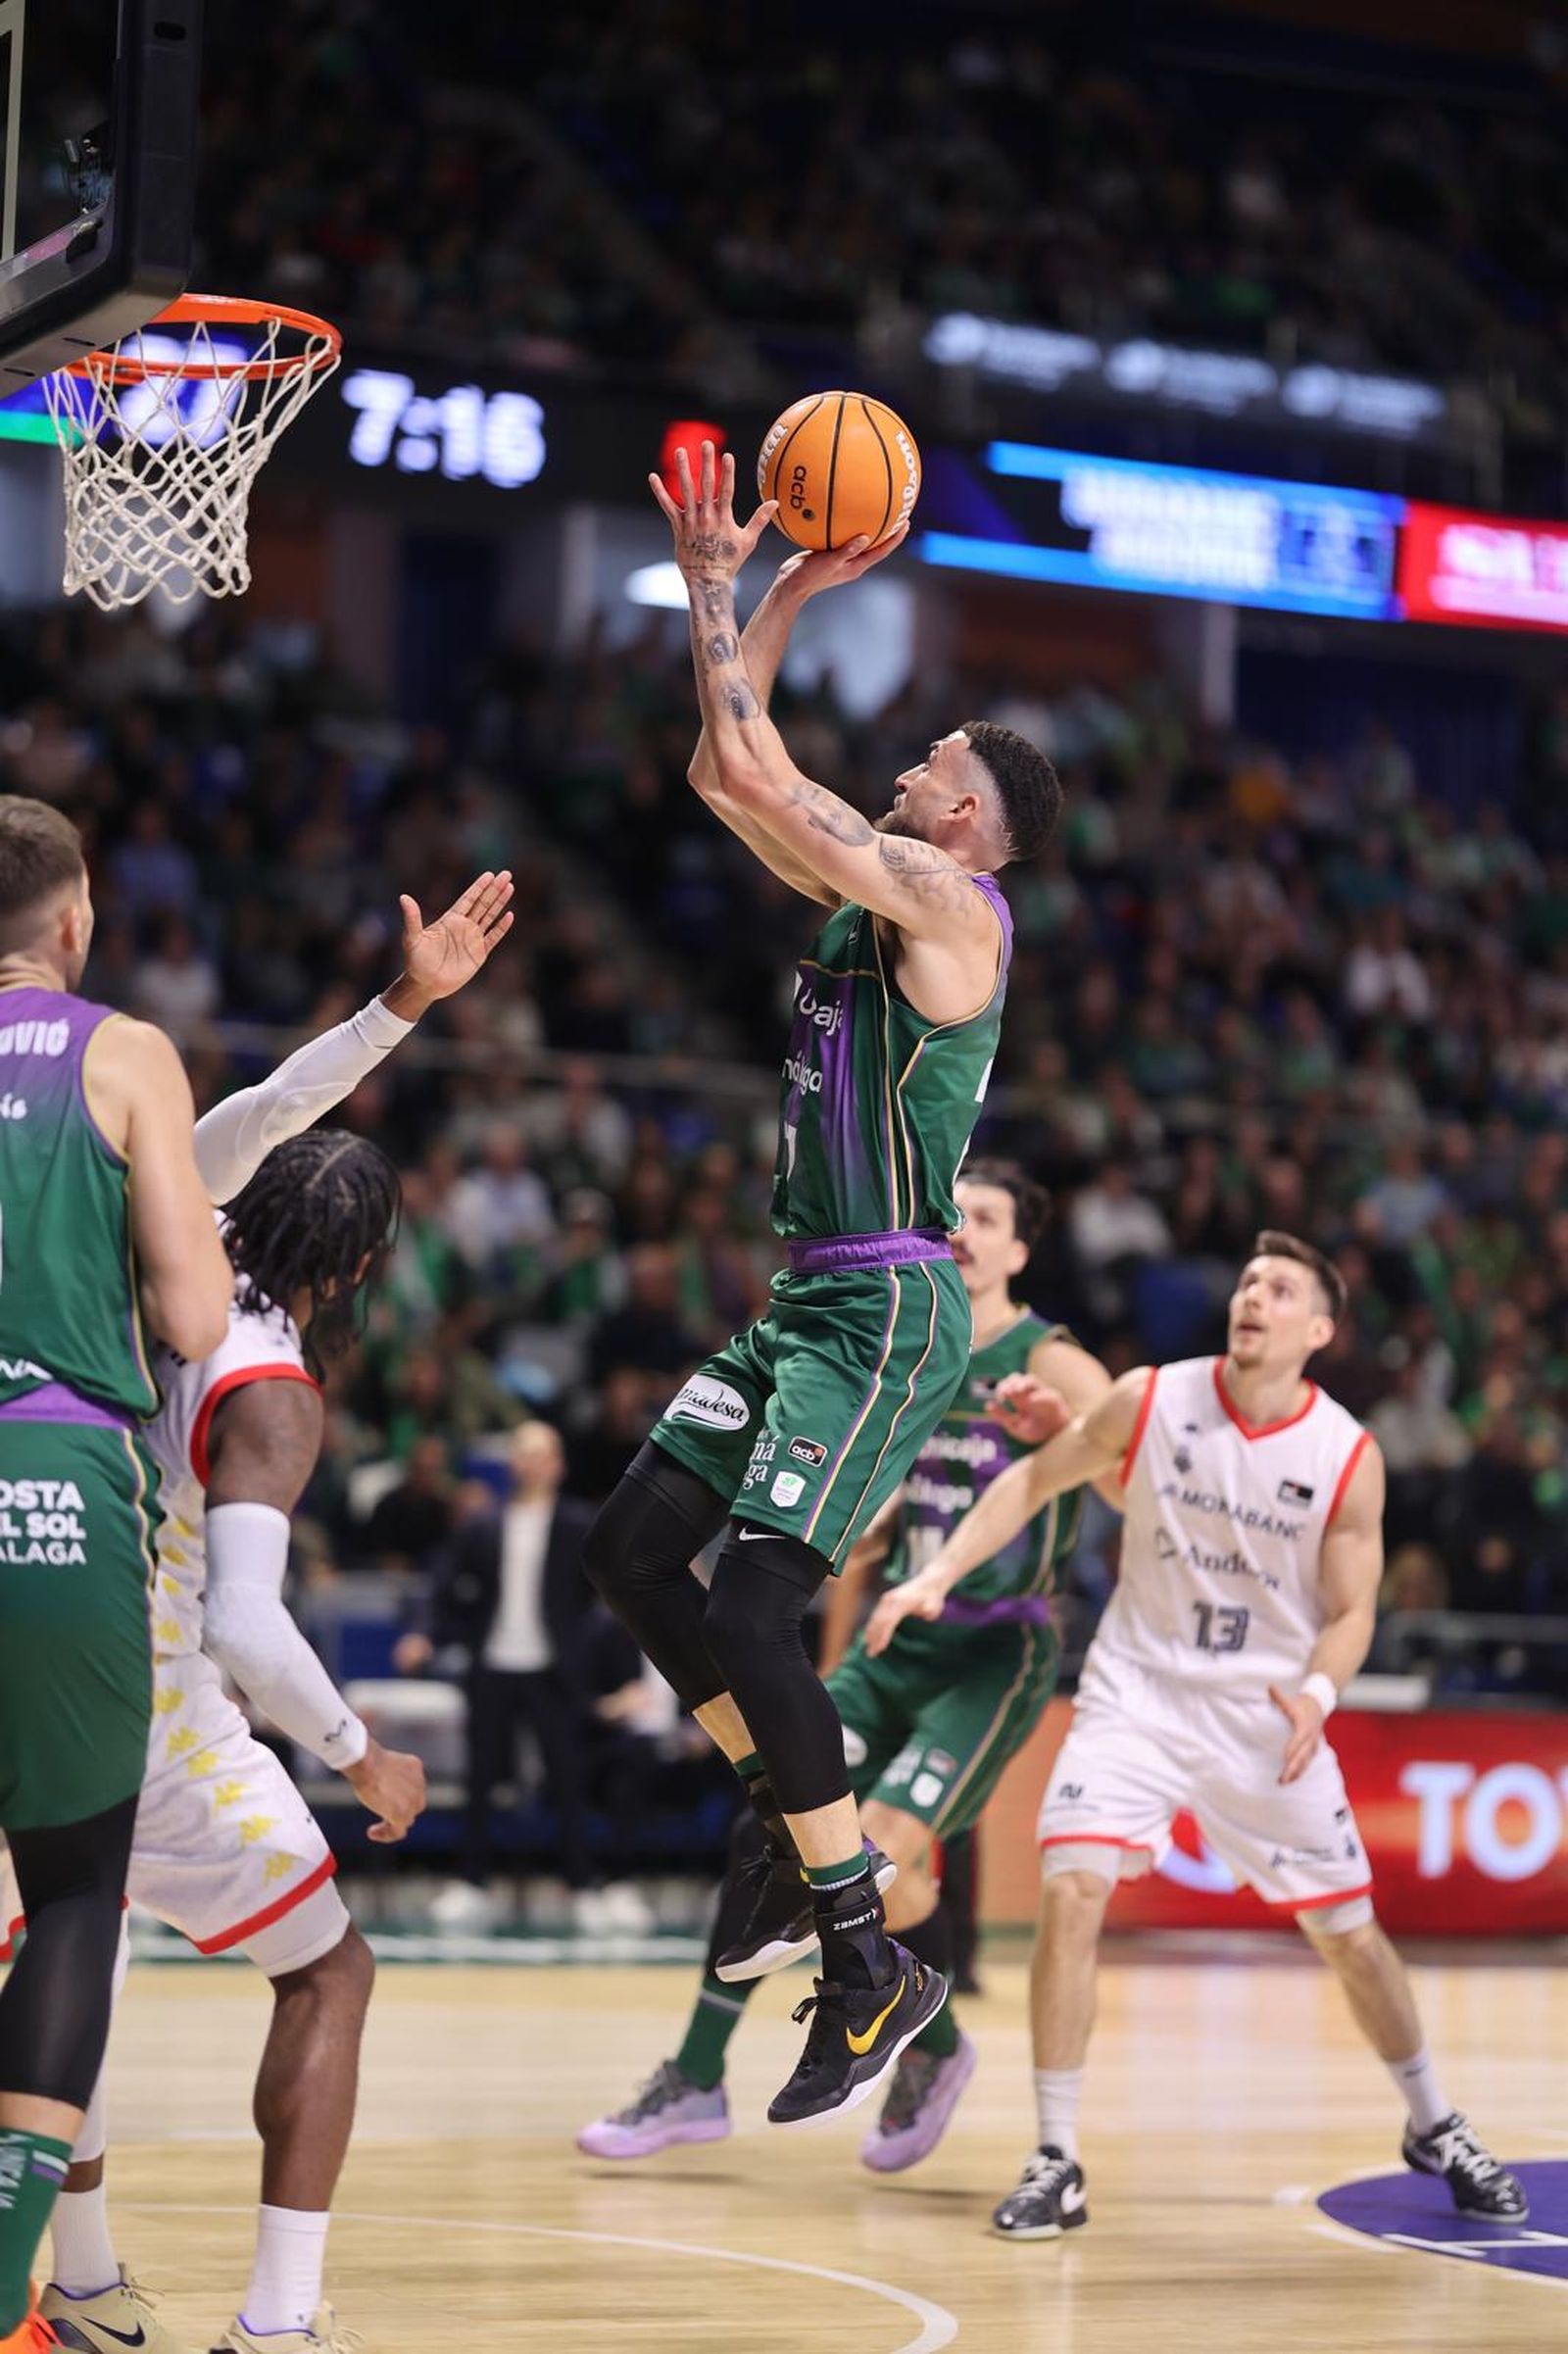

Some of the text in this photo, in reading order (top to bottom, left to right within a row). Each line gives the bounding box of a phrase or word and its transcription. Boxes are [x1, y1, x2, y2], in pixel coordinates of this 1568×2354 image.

[792, 466, 807, 509] acb
[791, 1445, 816, 1461] acb
[25, 1512, 87, 1540] SOL
[1193, 1600, 1250, 1652] 13
[1398, 1760, 1568, 1883] TO
